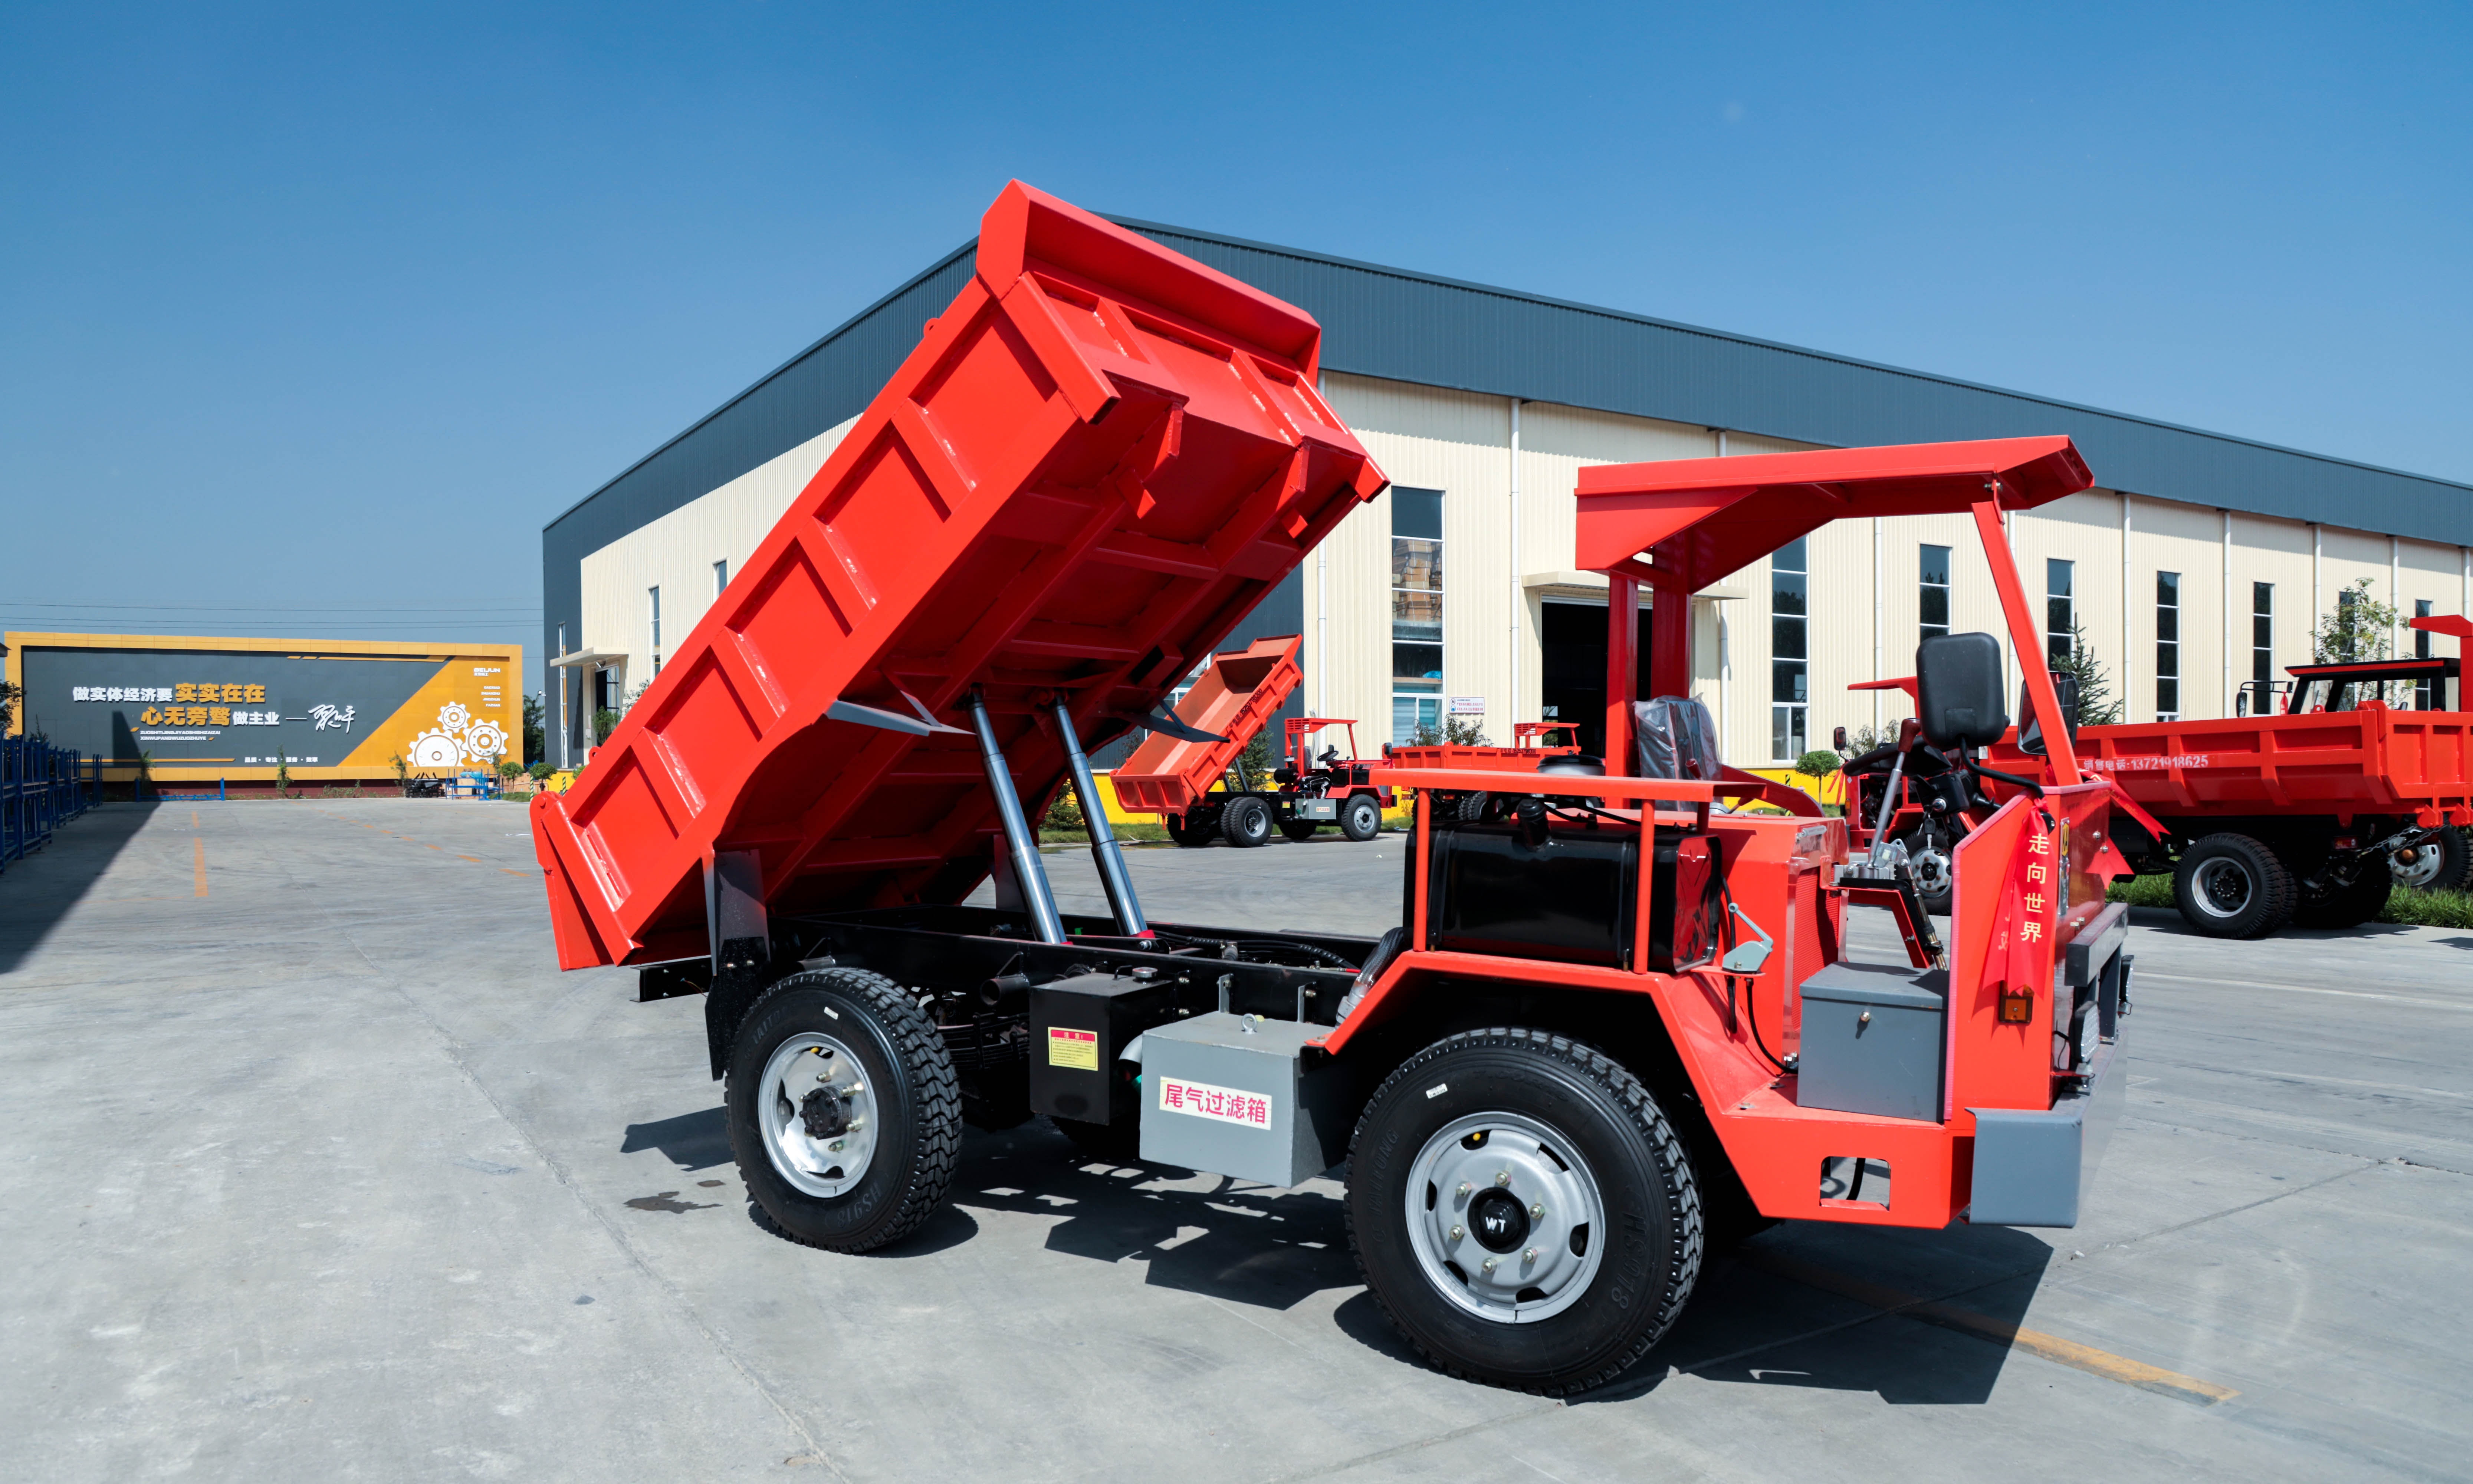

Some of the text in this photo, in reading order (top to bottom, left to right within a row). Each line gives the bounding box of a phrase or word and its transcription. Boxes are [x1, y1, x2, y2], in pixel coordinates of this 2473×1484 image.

[73, 683, 265, 702] 做实体经济要实实在在
[141, 706, 279, 726] 心无旁骛做主业
[2020, 833, 2049, 943] 走向世界
[1165, 1083, 1266, 1124] 尾气过滤箱
